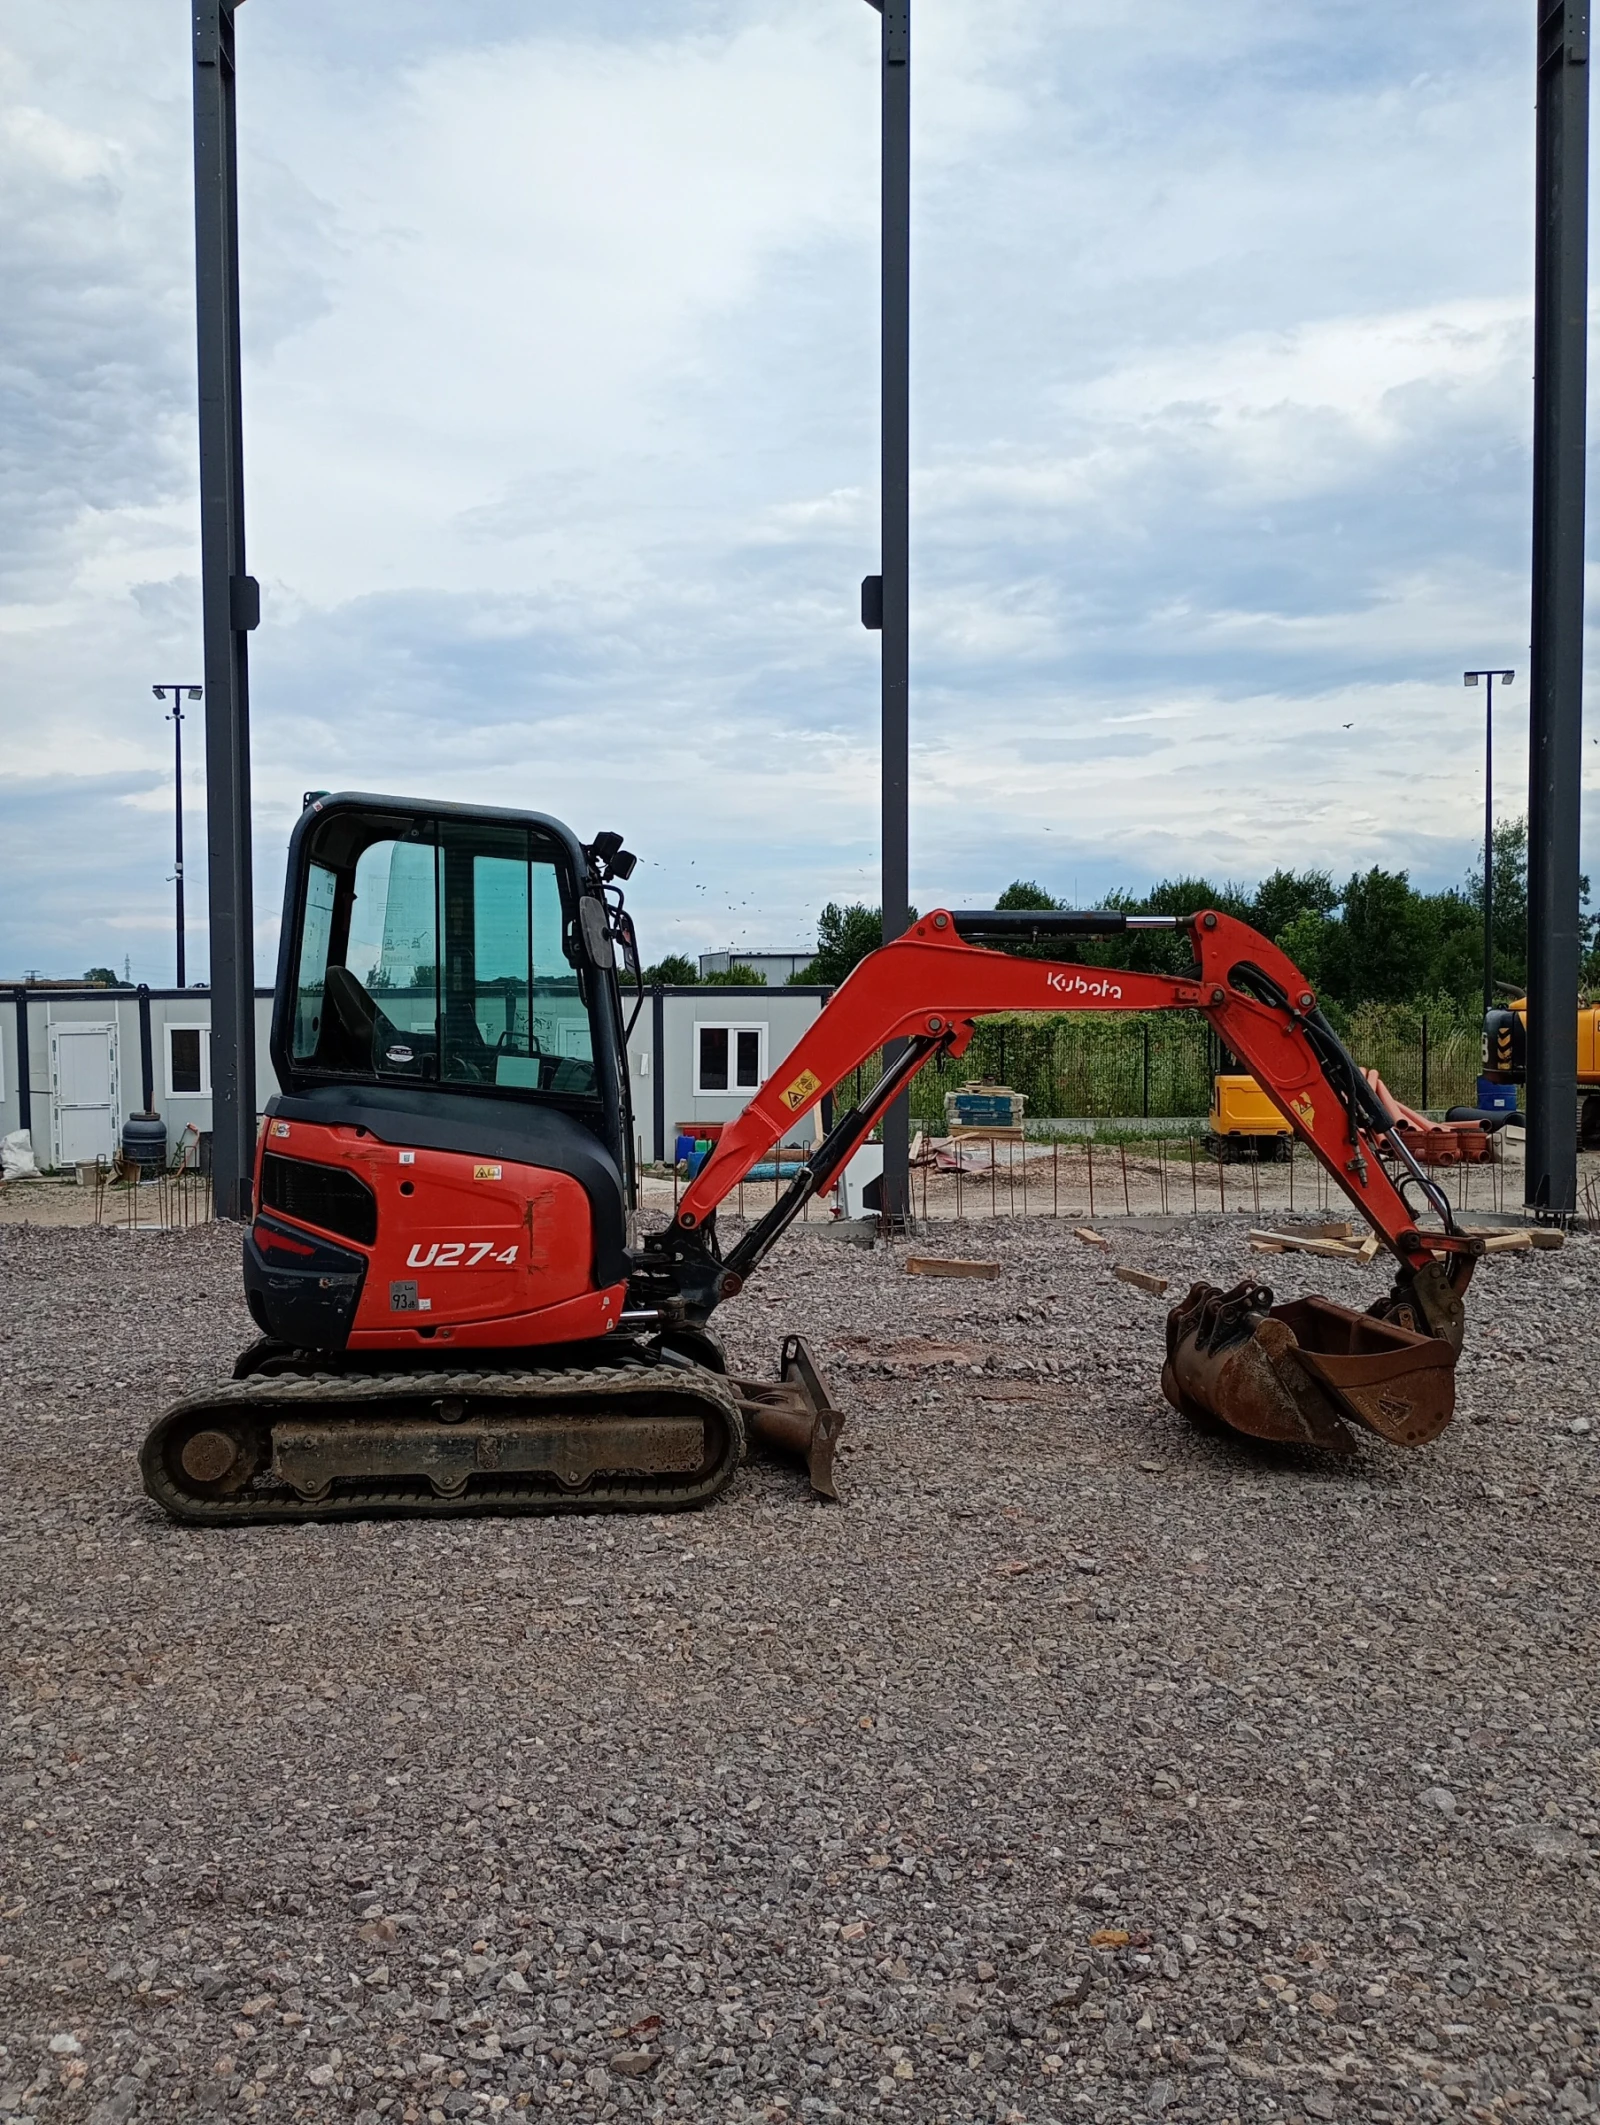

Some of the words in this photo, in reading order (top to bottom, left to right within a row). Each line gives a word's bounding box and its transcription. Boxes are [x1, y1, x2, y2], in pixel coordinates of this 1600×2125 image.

[1047, 971, 1122, 1010] Kubota
[406, 1242, 519, 1268] U27-4
[392, 1294, 408, 1309] 93
